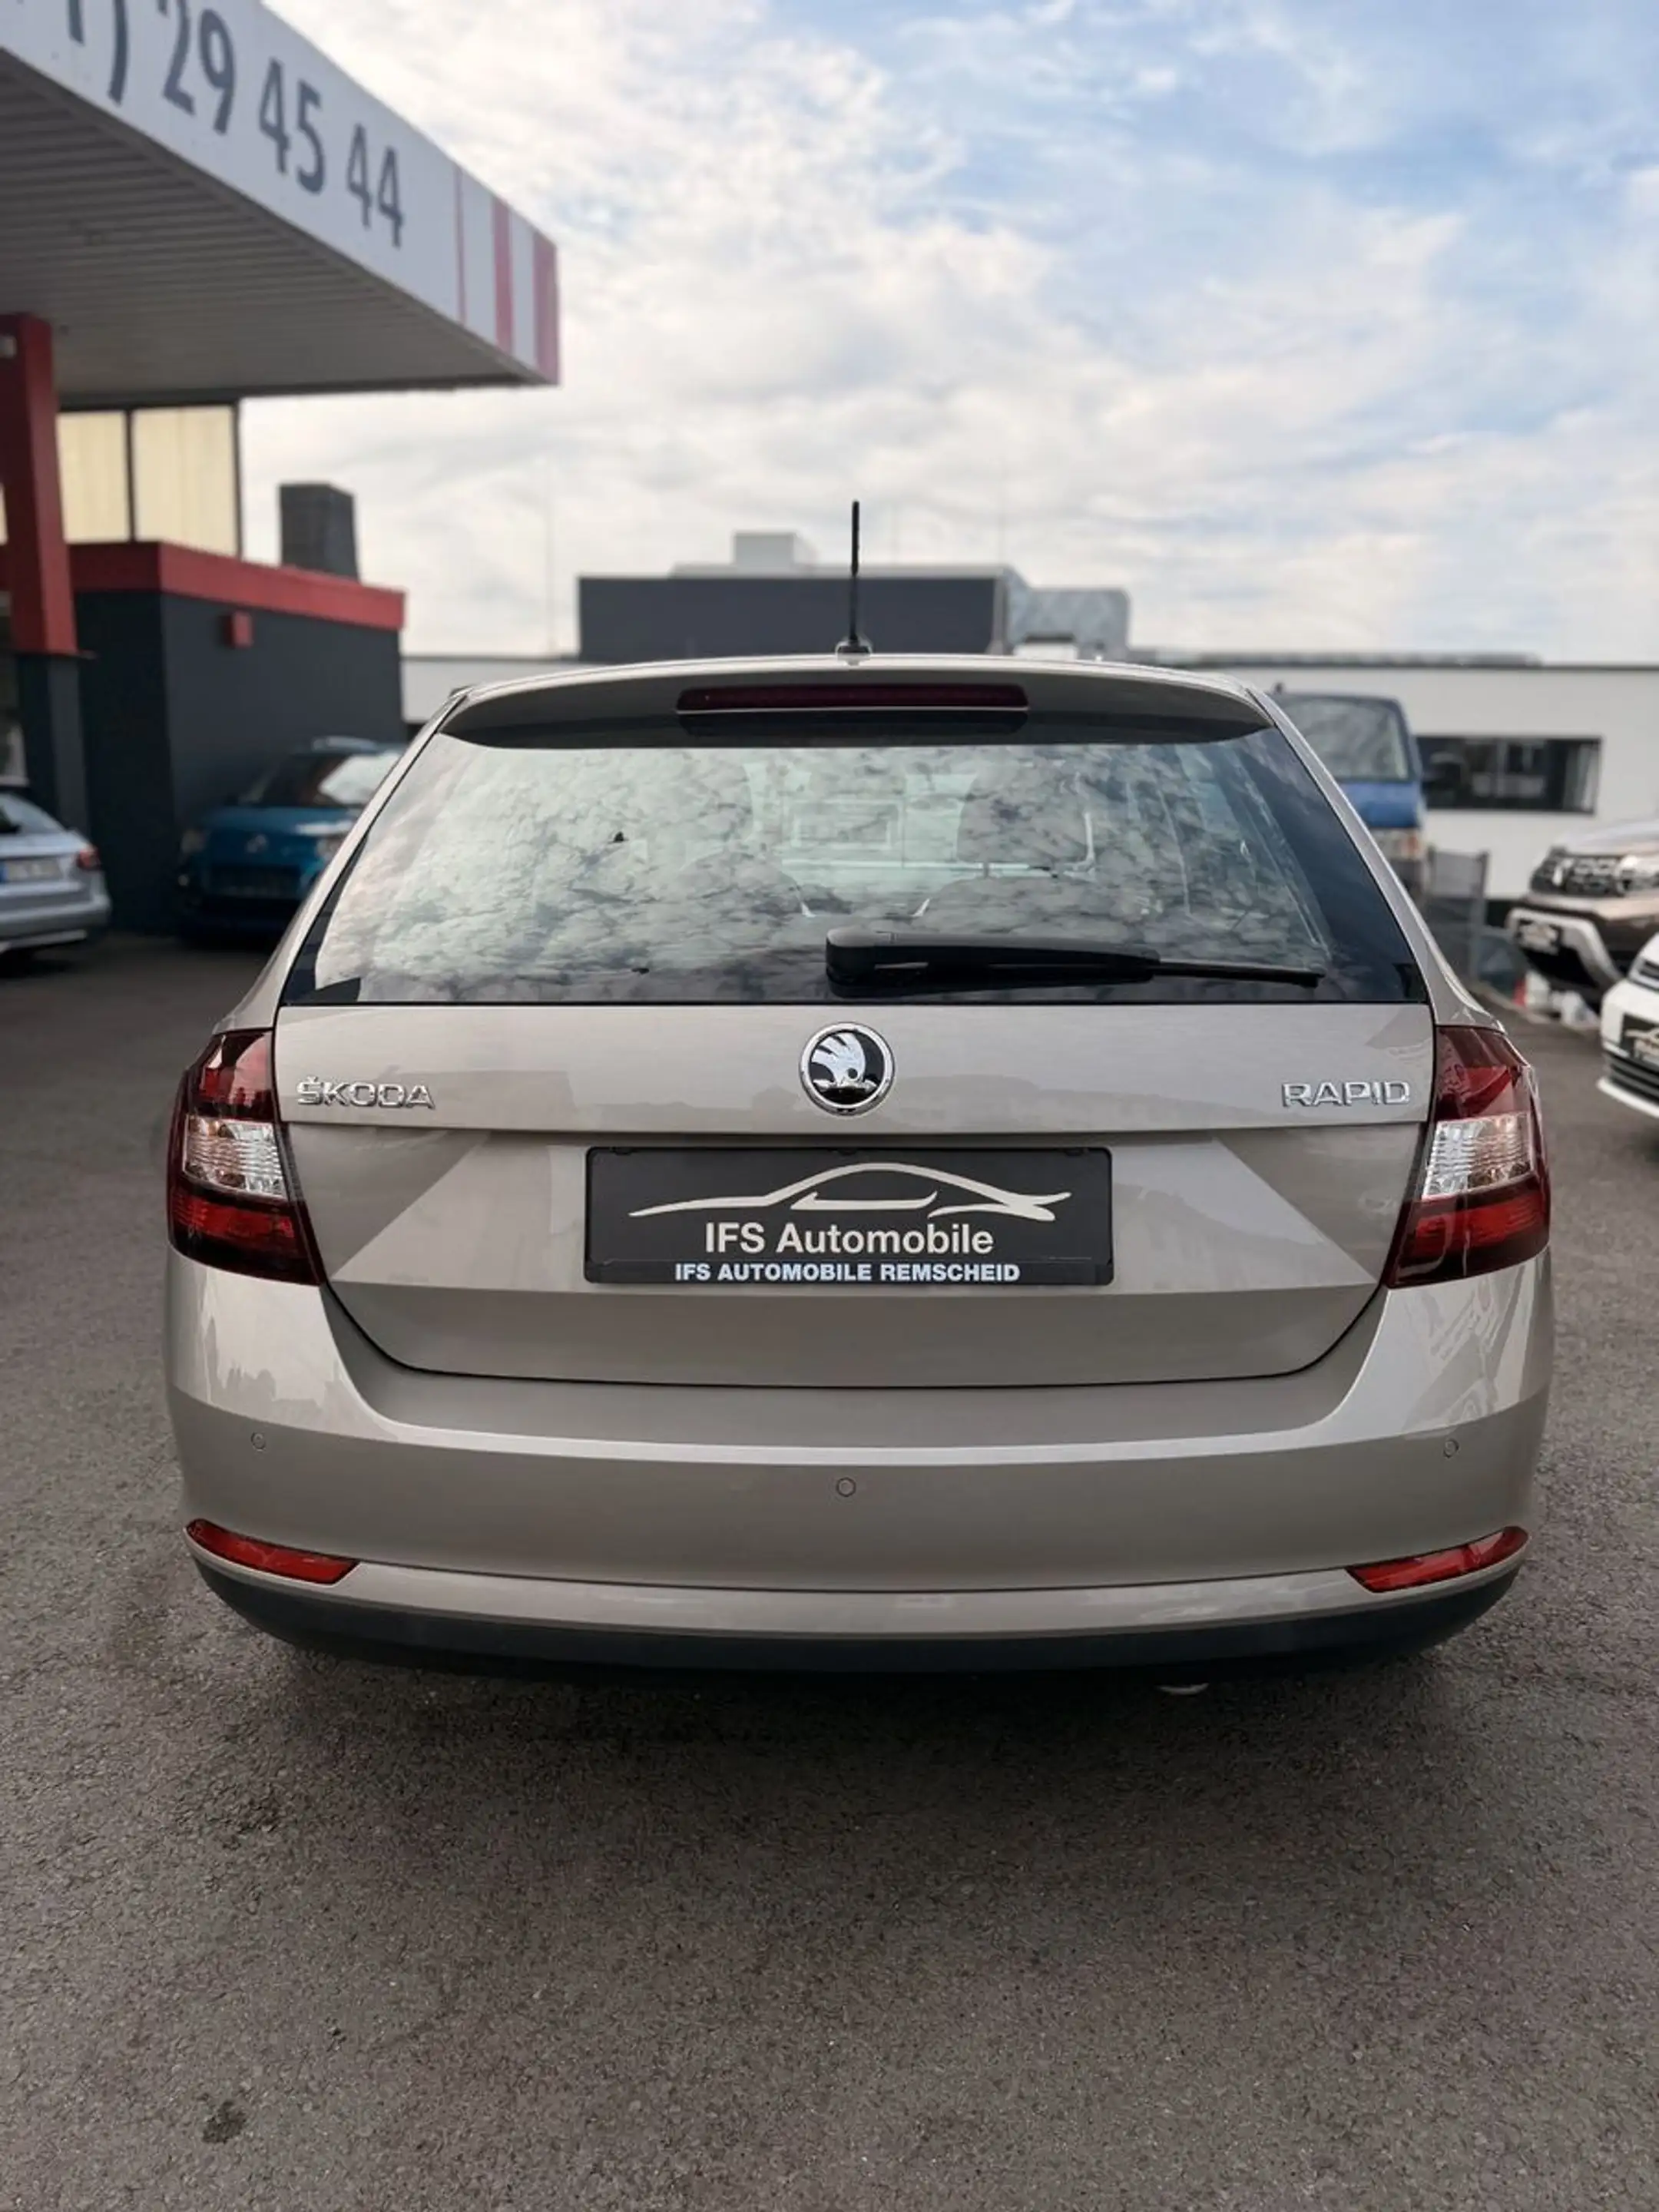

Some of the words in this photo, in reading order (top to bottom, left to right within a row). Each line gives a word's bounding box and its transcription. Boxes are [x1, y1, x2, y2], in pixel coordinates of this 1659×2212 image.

[158, 0, 235, 135] 29
[260, 57, 326, 195] 45
[347, 122, 403, 249] 44
[296, 1076, 435, 1109] ŠKODA
[1282, 1081, 1411, 1107] RAPID
[705, 1222, 765, 1253] IFS
[776, 1223, 994, 1253] Automobile
[675, 1263, 711, 1281] IFS
[717, 1263, 872, 1281] AUTOMOBILE
[880, 1263, 1021, 1282] REMSCHEID
